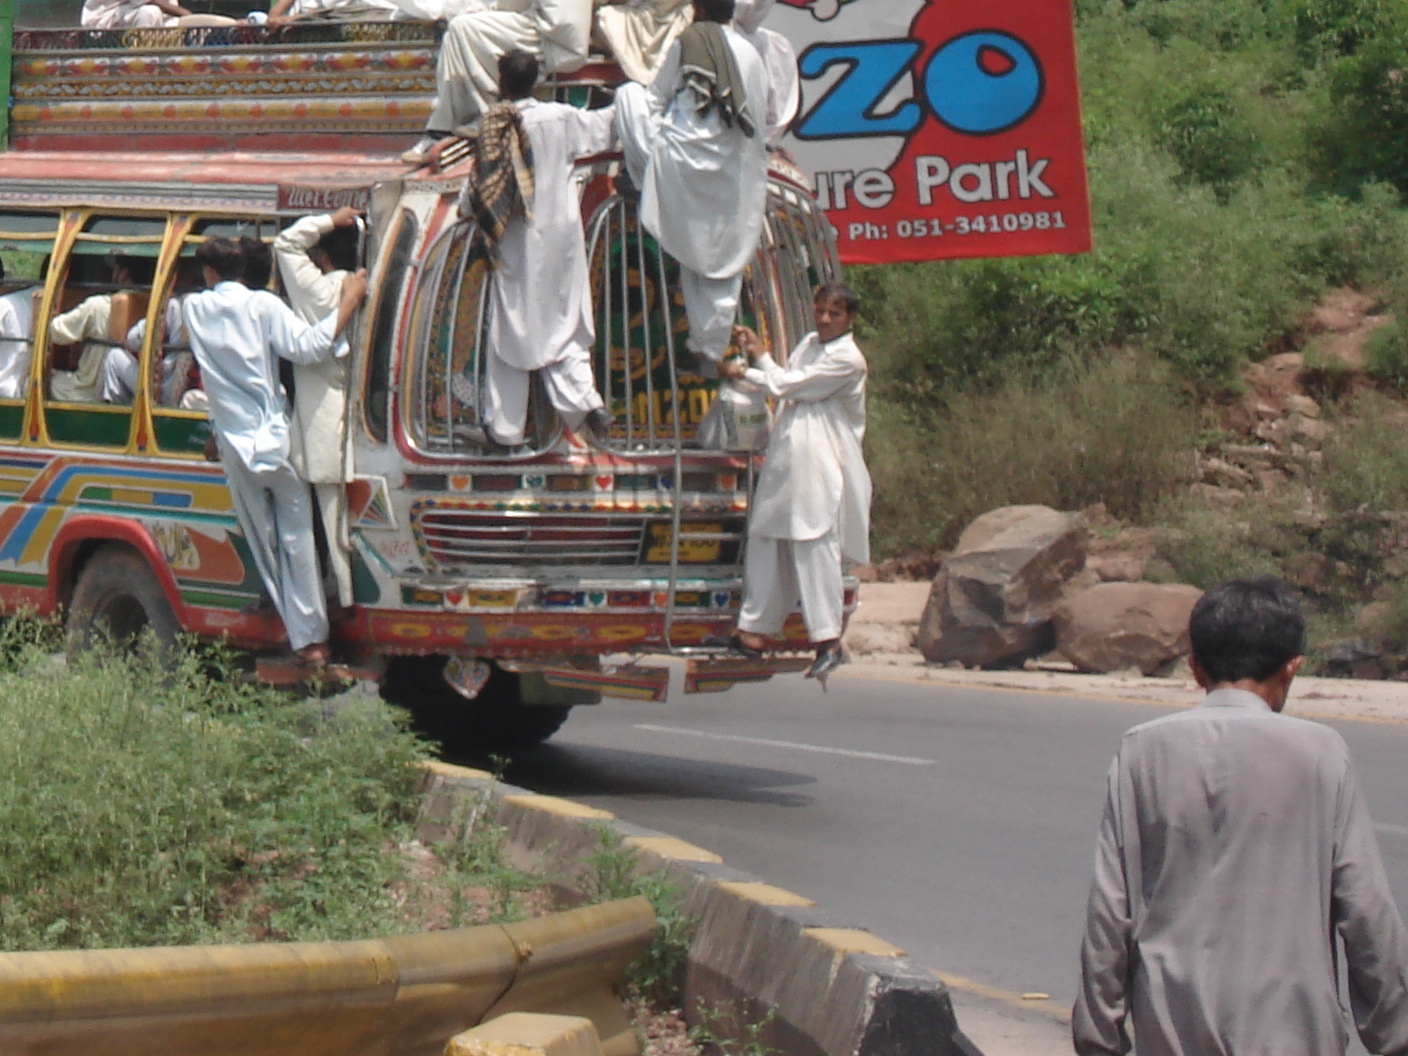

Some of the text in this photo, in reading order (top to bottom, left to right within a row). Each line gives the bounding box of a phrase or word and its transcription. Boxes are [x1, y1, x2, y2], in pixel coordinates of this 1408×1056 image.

[792, 28, 1045, 139] ZO
[815, 149, 1058, 211] ure Park
[848, 222, 888, 241] Ph:
[897, 211, 1067, 239] 051-3410981
